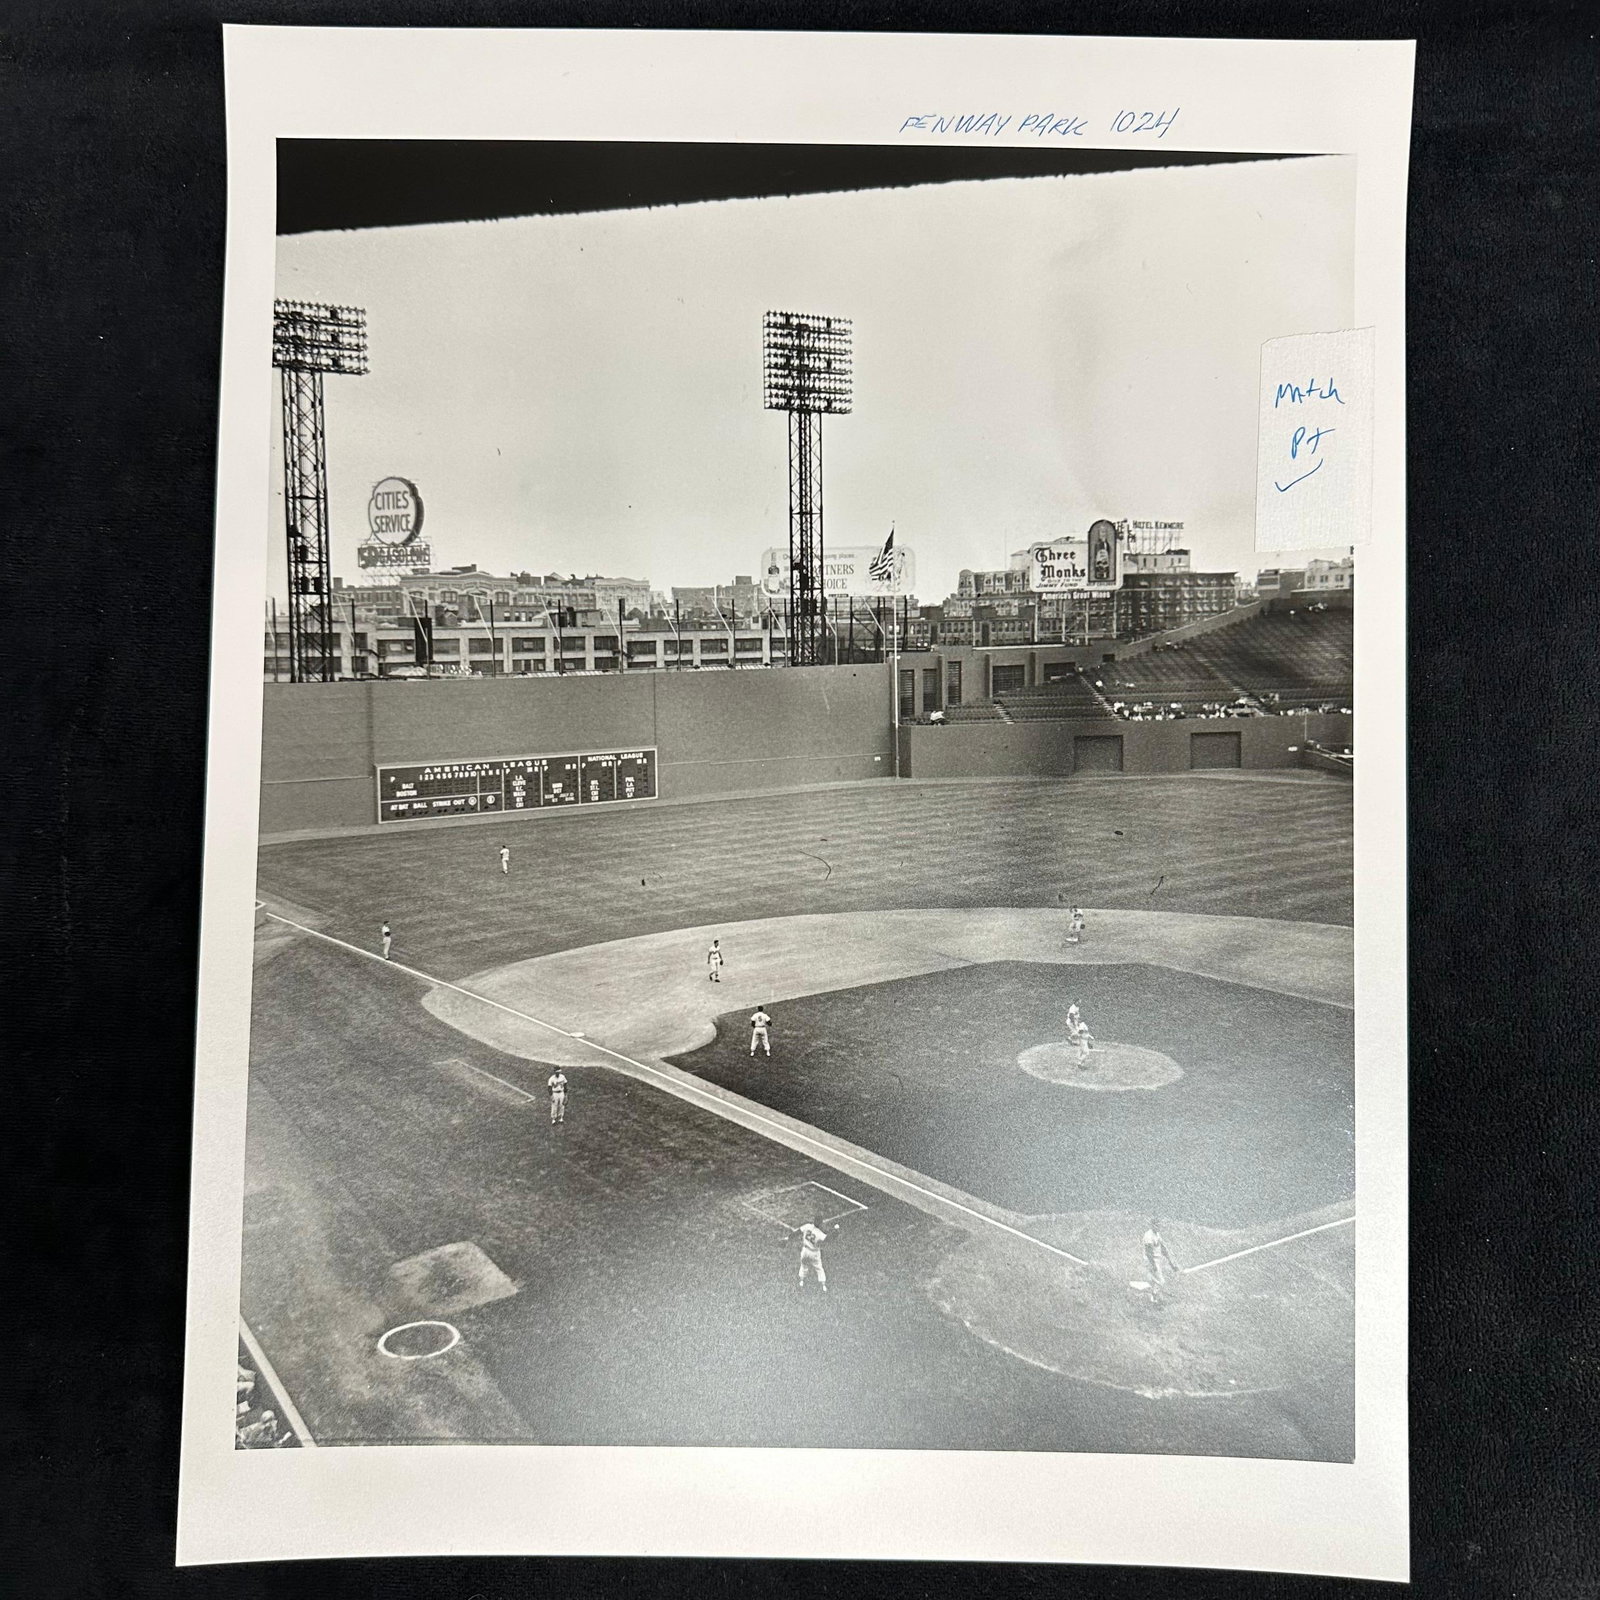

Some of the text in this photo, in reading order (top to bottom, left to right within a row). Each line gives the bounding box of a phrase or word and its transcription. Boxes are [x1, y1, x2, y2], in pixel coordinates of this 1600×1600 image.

[899, 107, 1181, 138] FENWAY PARK 1024
[375, 491, 409, 511] CITIES
[375, 514, 412, 533] SERVICE
[1035, 547, 1077, 563] Three
[1041, 563, 1086, 581] Monks
[587, 752, 643, 762] NATIONAL LEAGUE
[424, 760, 548, 773] AMERICAN LEAGUE
